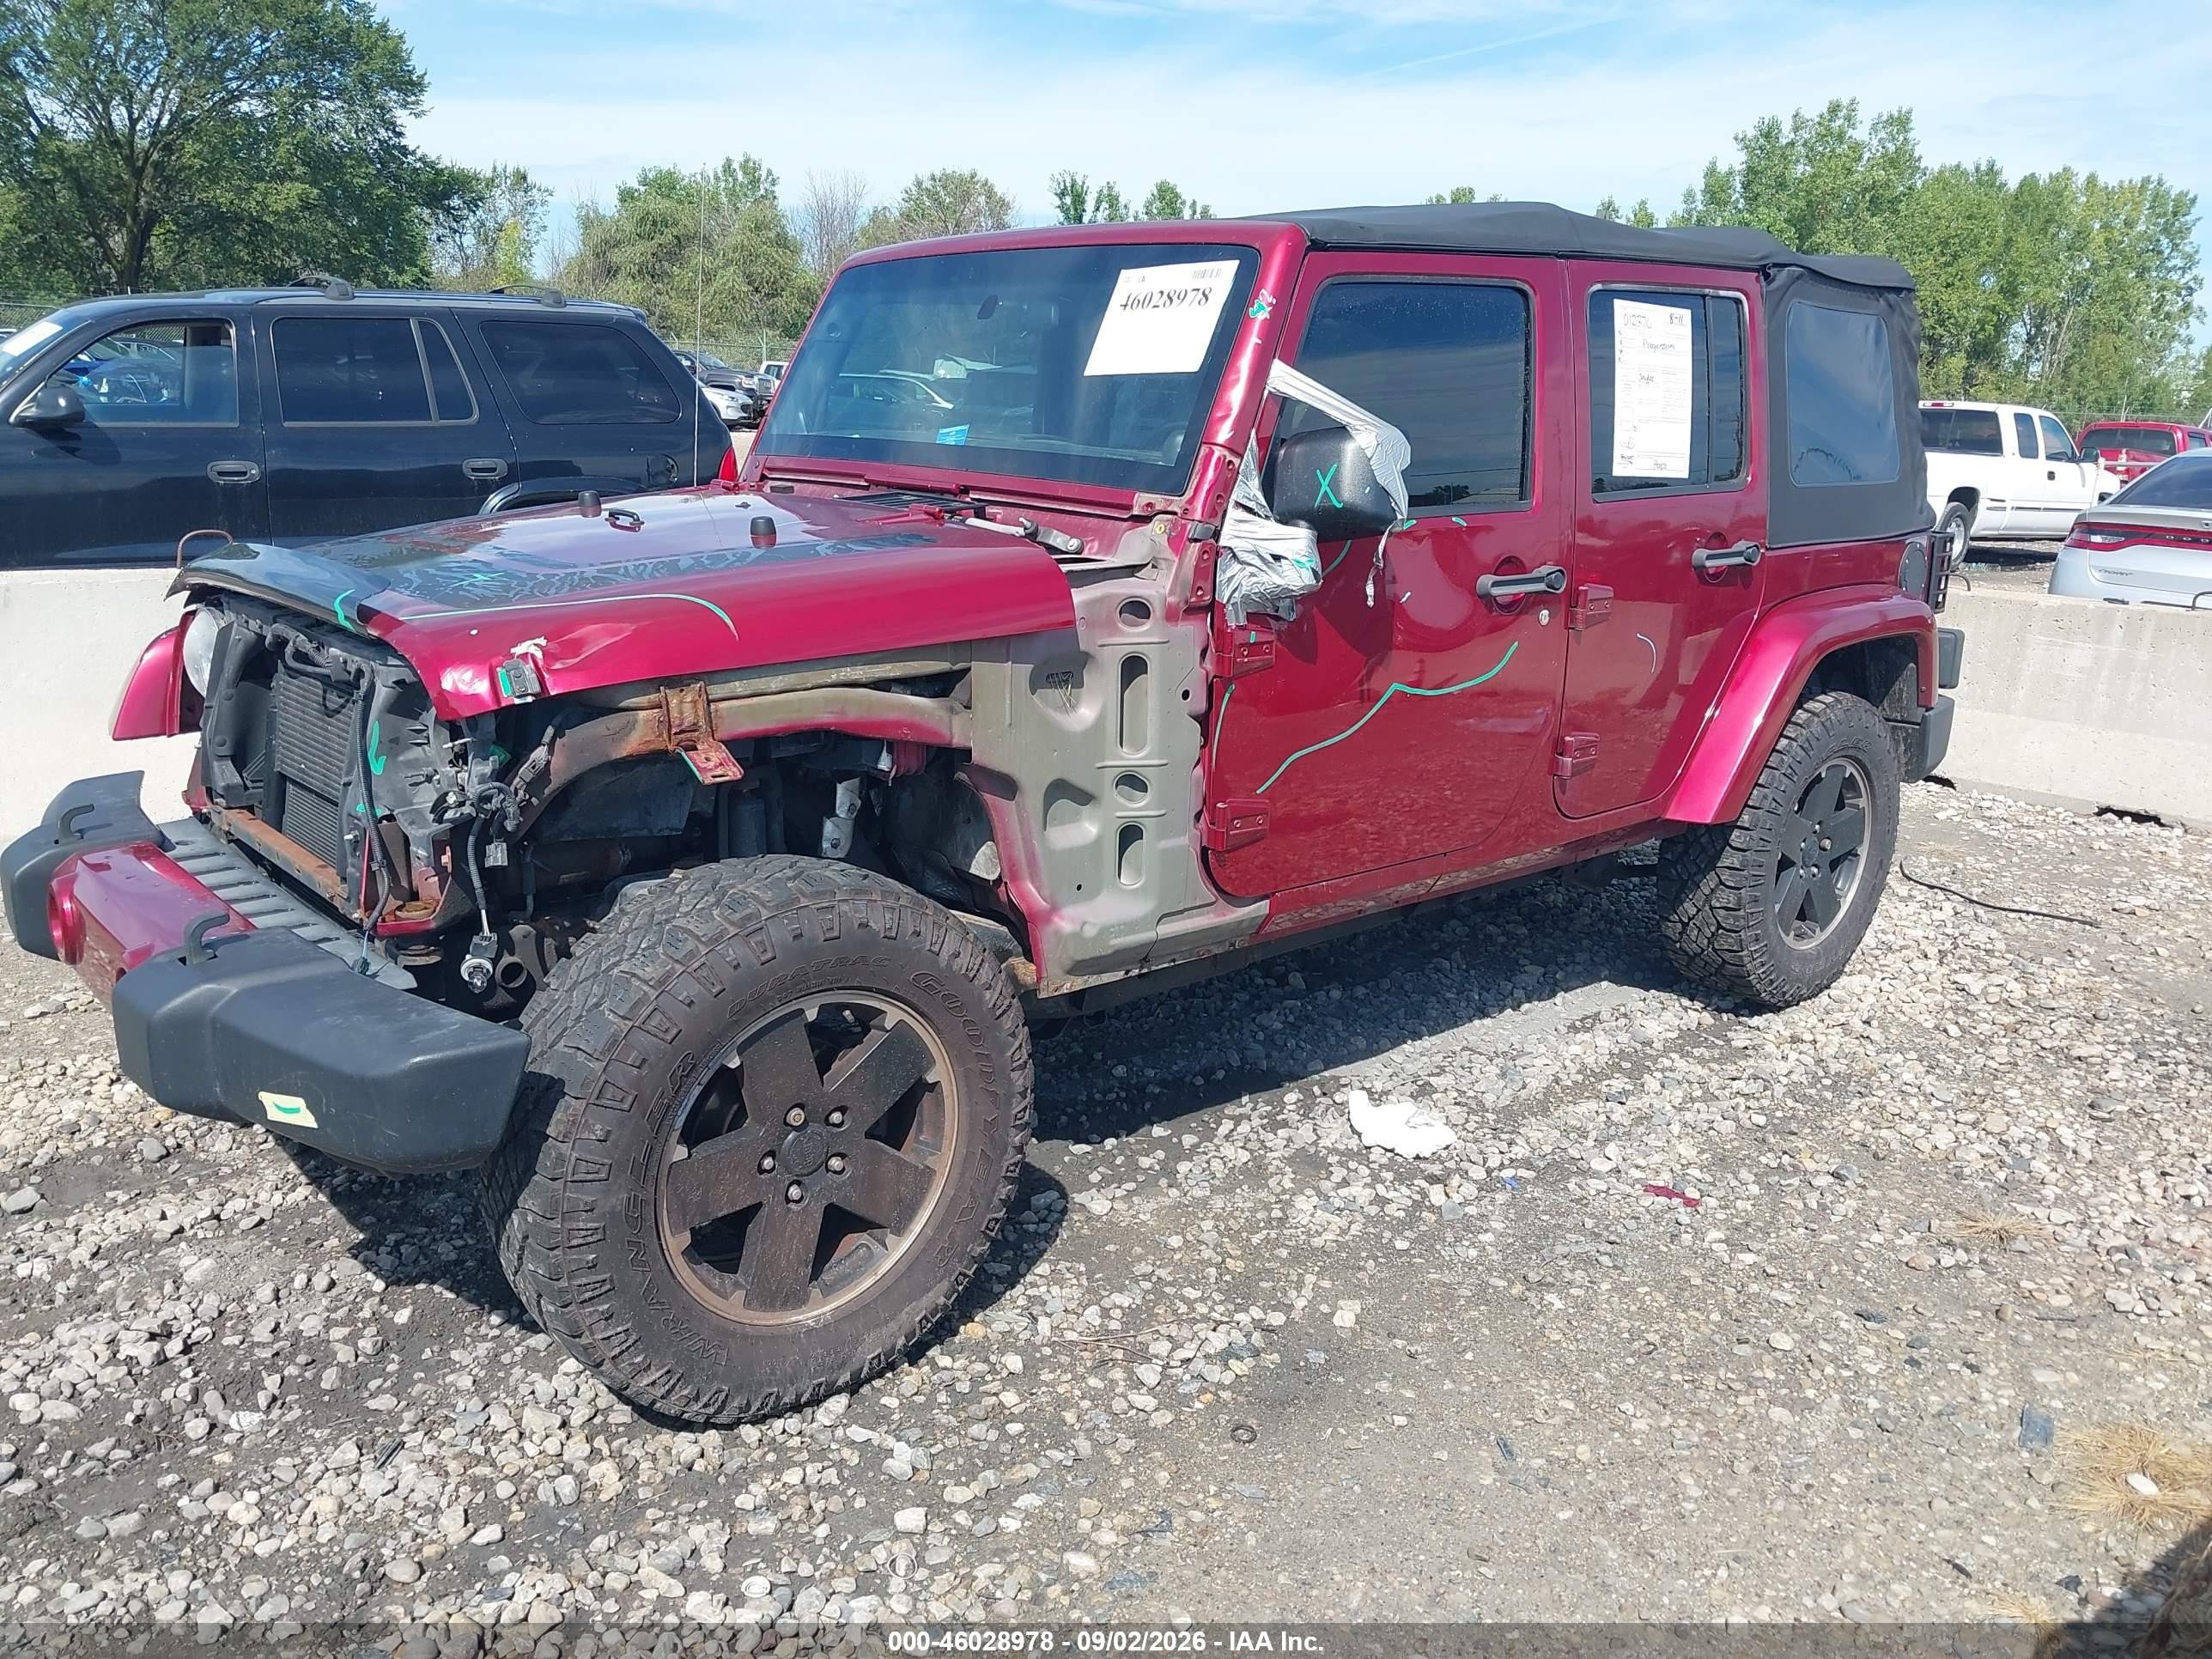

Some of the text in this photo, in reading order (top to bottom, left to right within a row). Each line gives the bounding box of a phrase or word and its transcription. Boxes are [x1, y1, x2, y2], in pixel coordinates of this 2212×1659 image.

[1119, 287, 1212, 311] 46028978
[728, 953, 894, 1020] DURATRAC
[623, 1050, 730, 1367] WRANGLER
[909, 971, 1000, 1267] GOODYEAR
